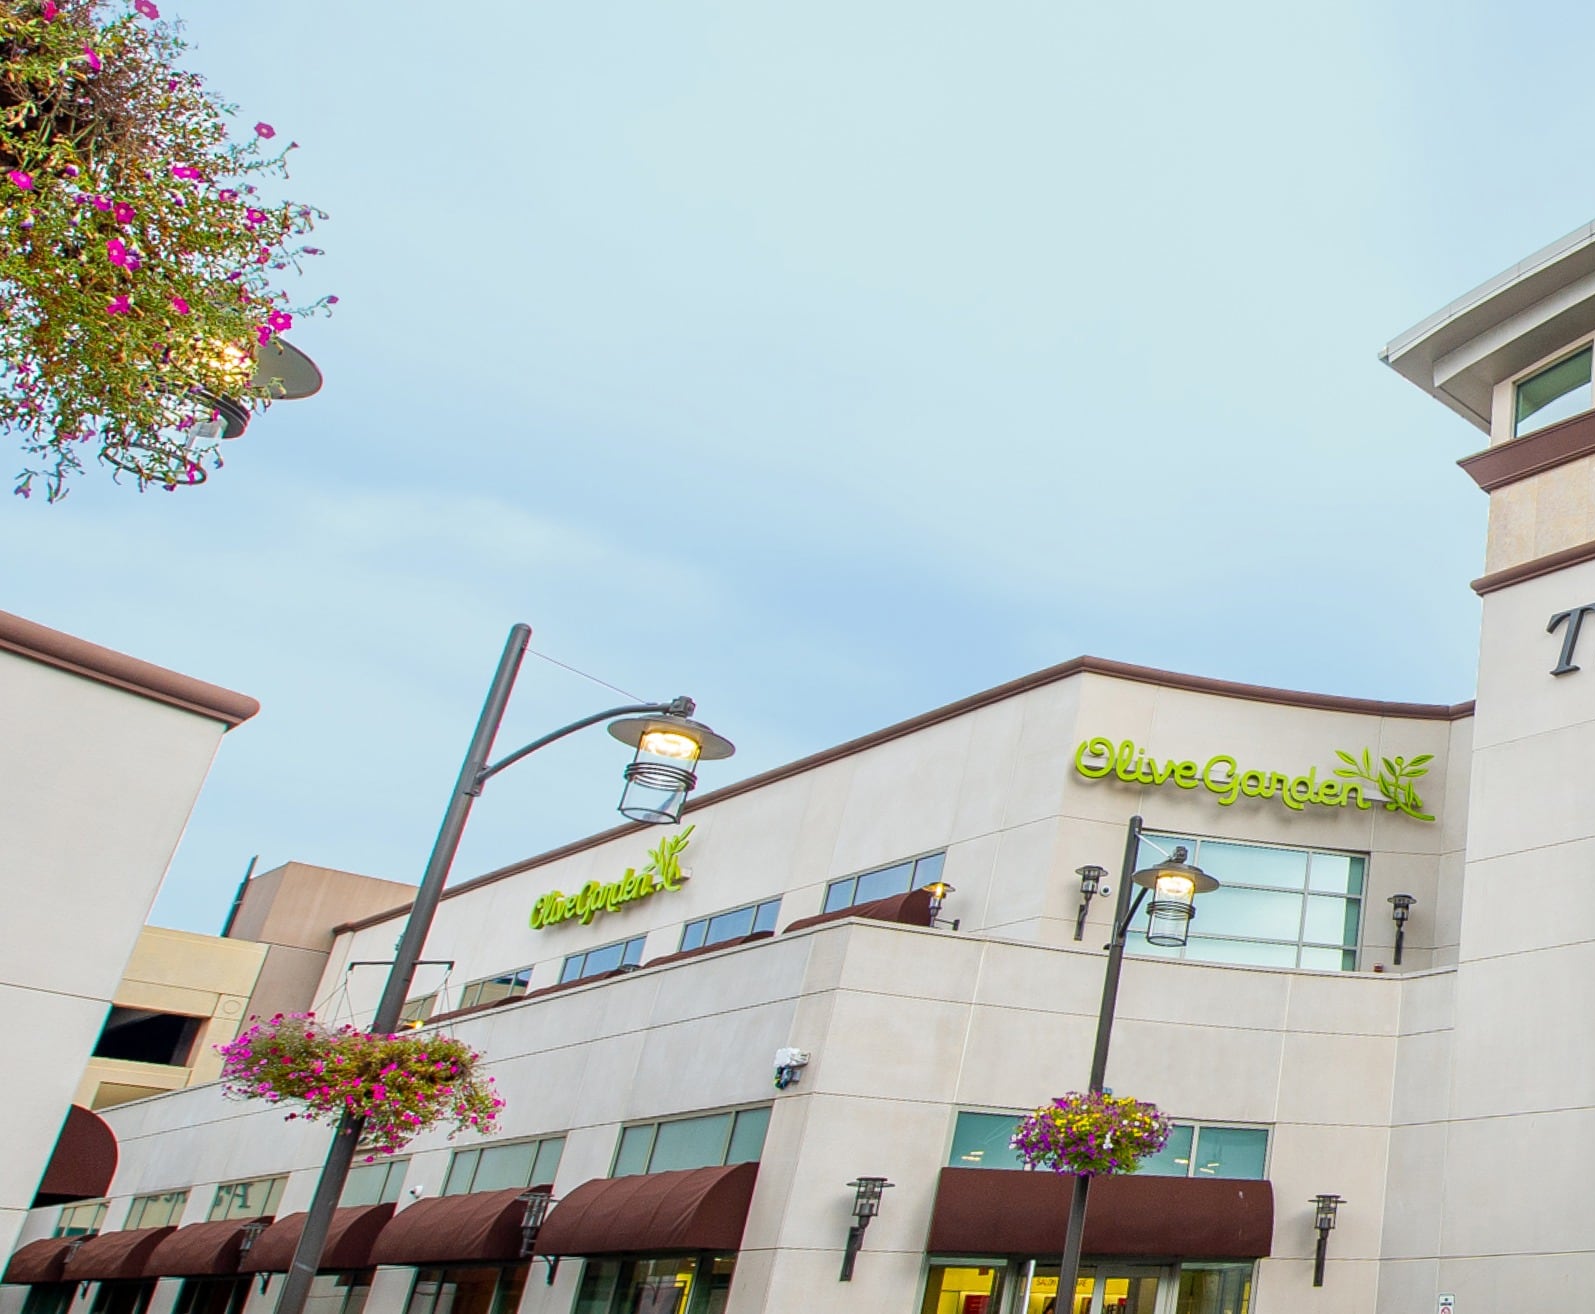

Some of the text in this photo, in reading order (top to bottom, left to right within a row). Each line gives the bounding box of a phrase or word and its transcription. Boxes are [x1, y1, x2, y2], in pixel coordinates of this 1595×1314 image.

[1074, 737, 1372, 810] Olive Garden
[529, 868, 654, 930] Olive Garden
